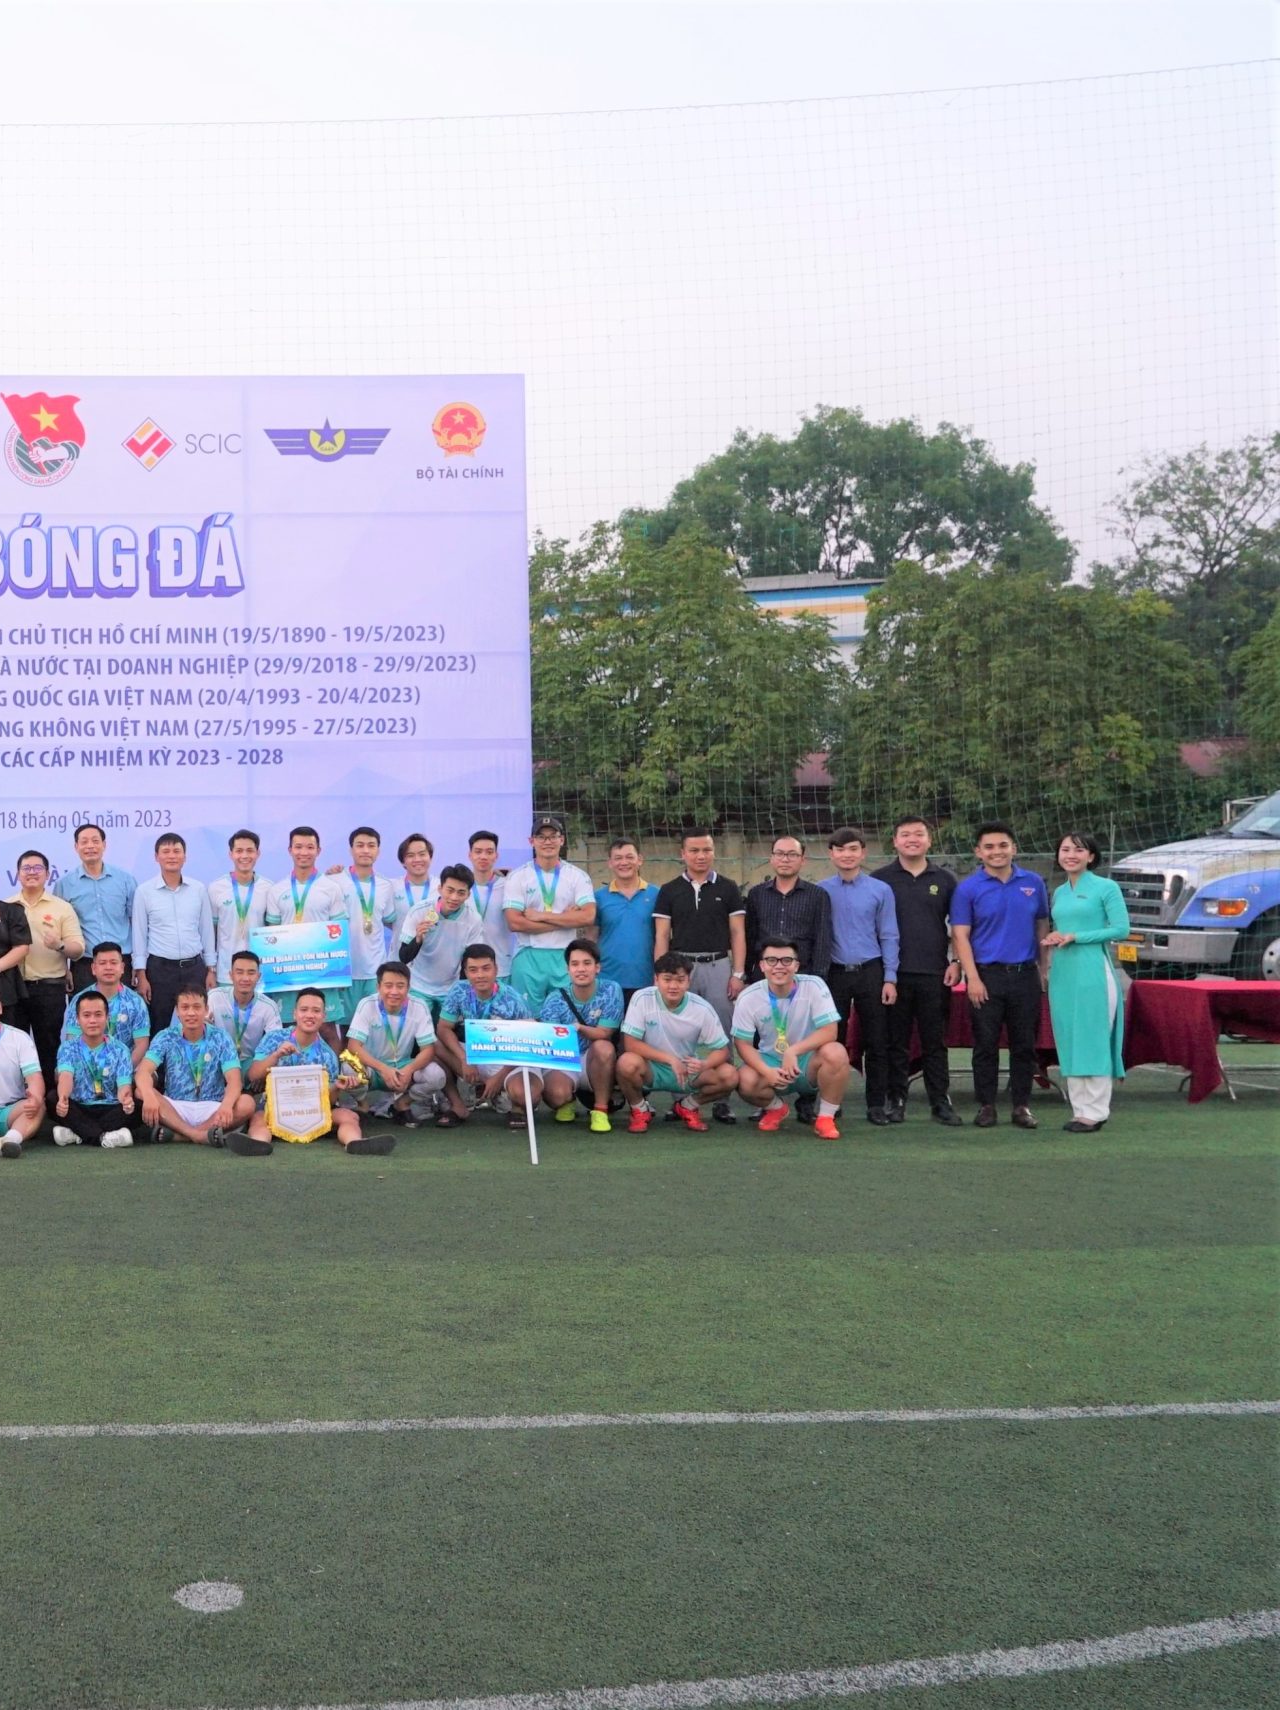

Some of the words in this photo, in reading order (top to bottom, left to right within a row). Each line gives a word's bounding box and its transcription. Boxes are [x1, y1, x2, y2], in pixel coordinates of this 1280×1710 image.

[185, 433, 242, 455] SCIC
[416, 466, 434, 482] BỘ
[438, 465, 458, 479] TÀI
[462, 463, 504, 479] CHÍNH
[148, 511, 245, 598] ĐÁ
[9, 622, 46, 646] CHỦ
[51, 627, 93, 650] TỊCH
[99, 622, 125, 645] HỒ
[130, 623, 161, 645] CHÍ
[166, 626, 217, 645] MINH
[223, 624, 326, 647] (19/5/1890
[343, 623, 445, 645] 19/5/2023)
[16, 654, 69, 677] NƯỚC
[75, 657, 101, 679] TẠI
[107, 657, 173, 676] DOANH
[179, 653, 249, 680] NGHIỆP
[254, 655, 357, 678] (29/9/2018
[374, 653, 476, 675] 29/9/2023)
[11, 683, 64, 709] QUỐC
[67, 688, 101, 707] GIA
[103, 685, 145, 711] VIỆT
[149, 688, 193, 707] NAM
[197, 687, 301, 709] (20/4/1993
[316, 685, 421, 706] 20/4/2023)
[29, 716, 96, 738] KHÔNG
[99, 716, 141, 743] VIỆT
[145, 719, 189, 737] NAM
[193, 718, 297, 740] (27/5/1995
[313, 716, 417, 737] 27/5/2023)
[0, 746, 36, 769] CÁC
[38, 744, 76, 768] CẤP
[80, 745, 144, 772] NHIỆM
[147, 745, 173, 767] KỲ
[175, 748, 221, 767] 2023
[236, 747, 284, 766] 2028
[0, 811, 18, 829] 18
[21, 810, 68, 833] tháng
[71, 811, 91, 827] 05
[95, 810, 130, 828] năm
[134, 809, 173, 828] 2023
